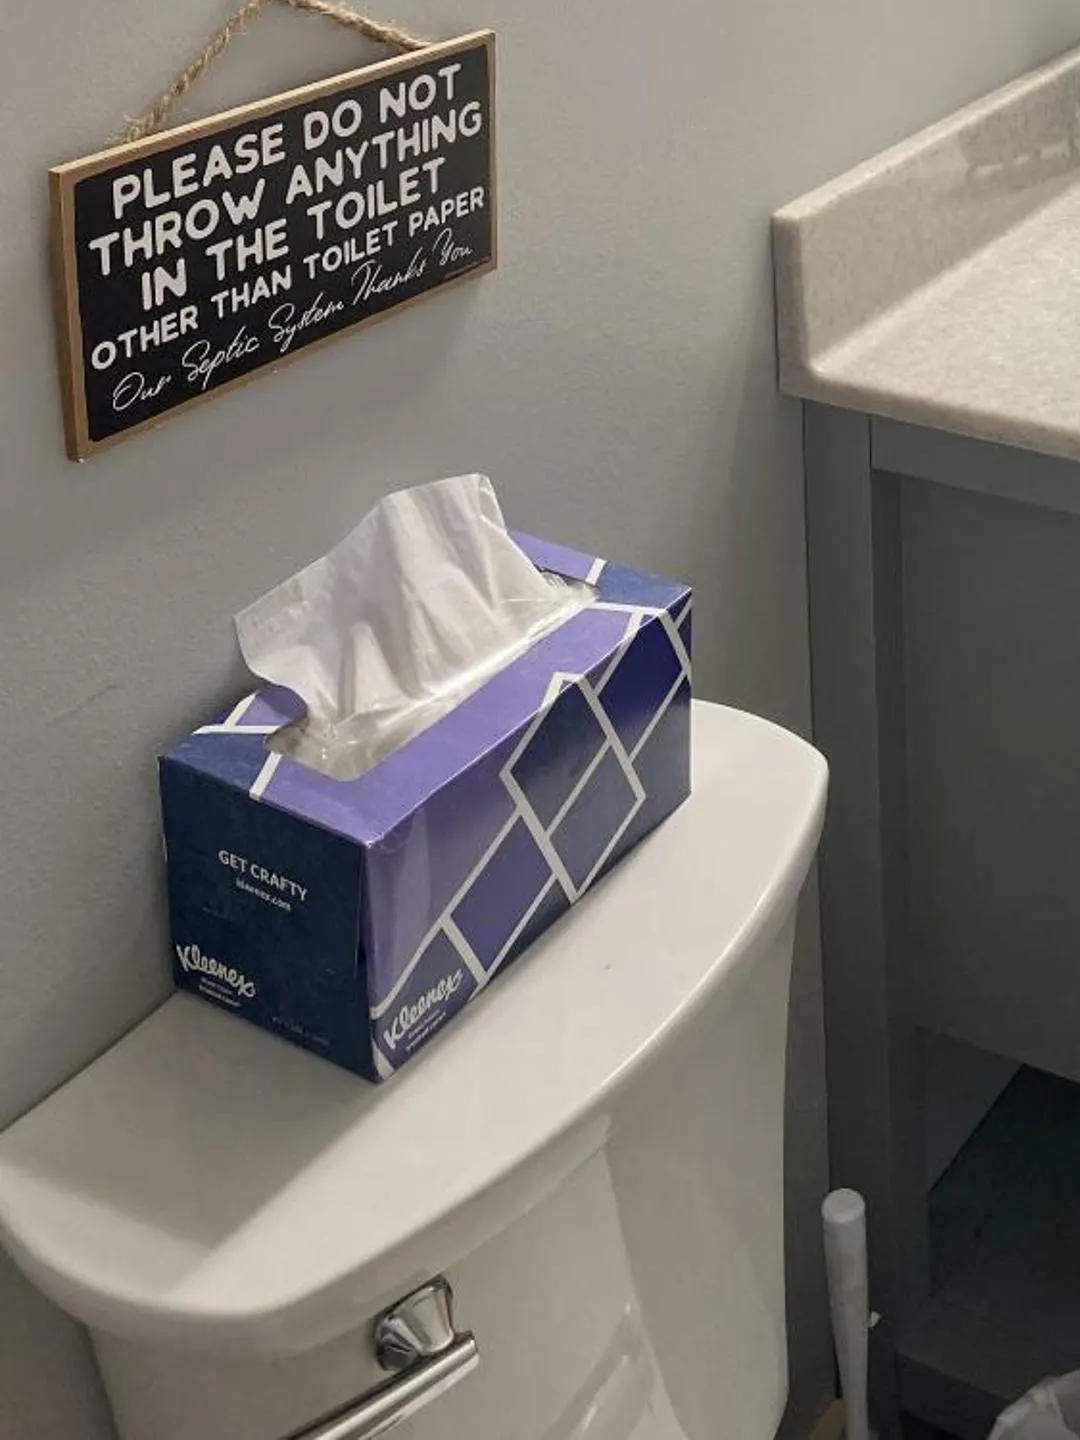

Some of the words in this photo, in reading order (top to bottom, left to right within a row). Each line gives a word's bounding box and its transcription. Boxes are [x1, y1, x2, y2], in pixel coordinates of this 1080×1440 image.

[89, 178, 266, 276] THROW
[285, 101, 483, 205] ANYTHING
[111, 124, 287, 220] PLEASE
[303, 99, 363, 150] DO
[379, 63, 462, 124] NOT
[91, 305, 198, 371] OTHER
[210, 266, 292, 320] THAN
[303, 220, 398, 280] TOILET
[408, 186, 485, 239] PAPER
[141, 258, 187, 311] IN
[206, 219, 290, 281] THE
[306, 157, 446, 240] TOILET
[112, 372, 173, 412] Our
[181, 325, 260, 389] Septic
[267, 289, 345, 352] System
[350, 246, 426, 305] Thanks
[431, 227, 474, 266] You
[218, 850, 248, 873] GET
[250, 863, 308, 902] CRAFTY
[176, 944, 257, 998] Kleenex
[383, 968, 464, 1050] Kleenex
